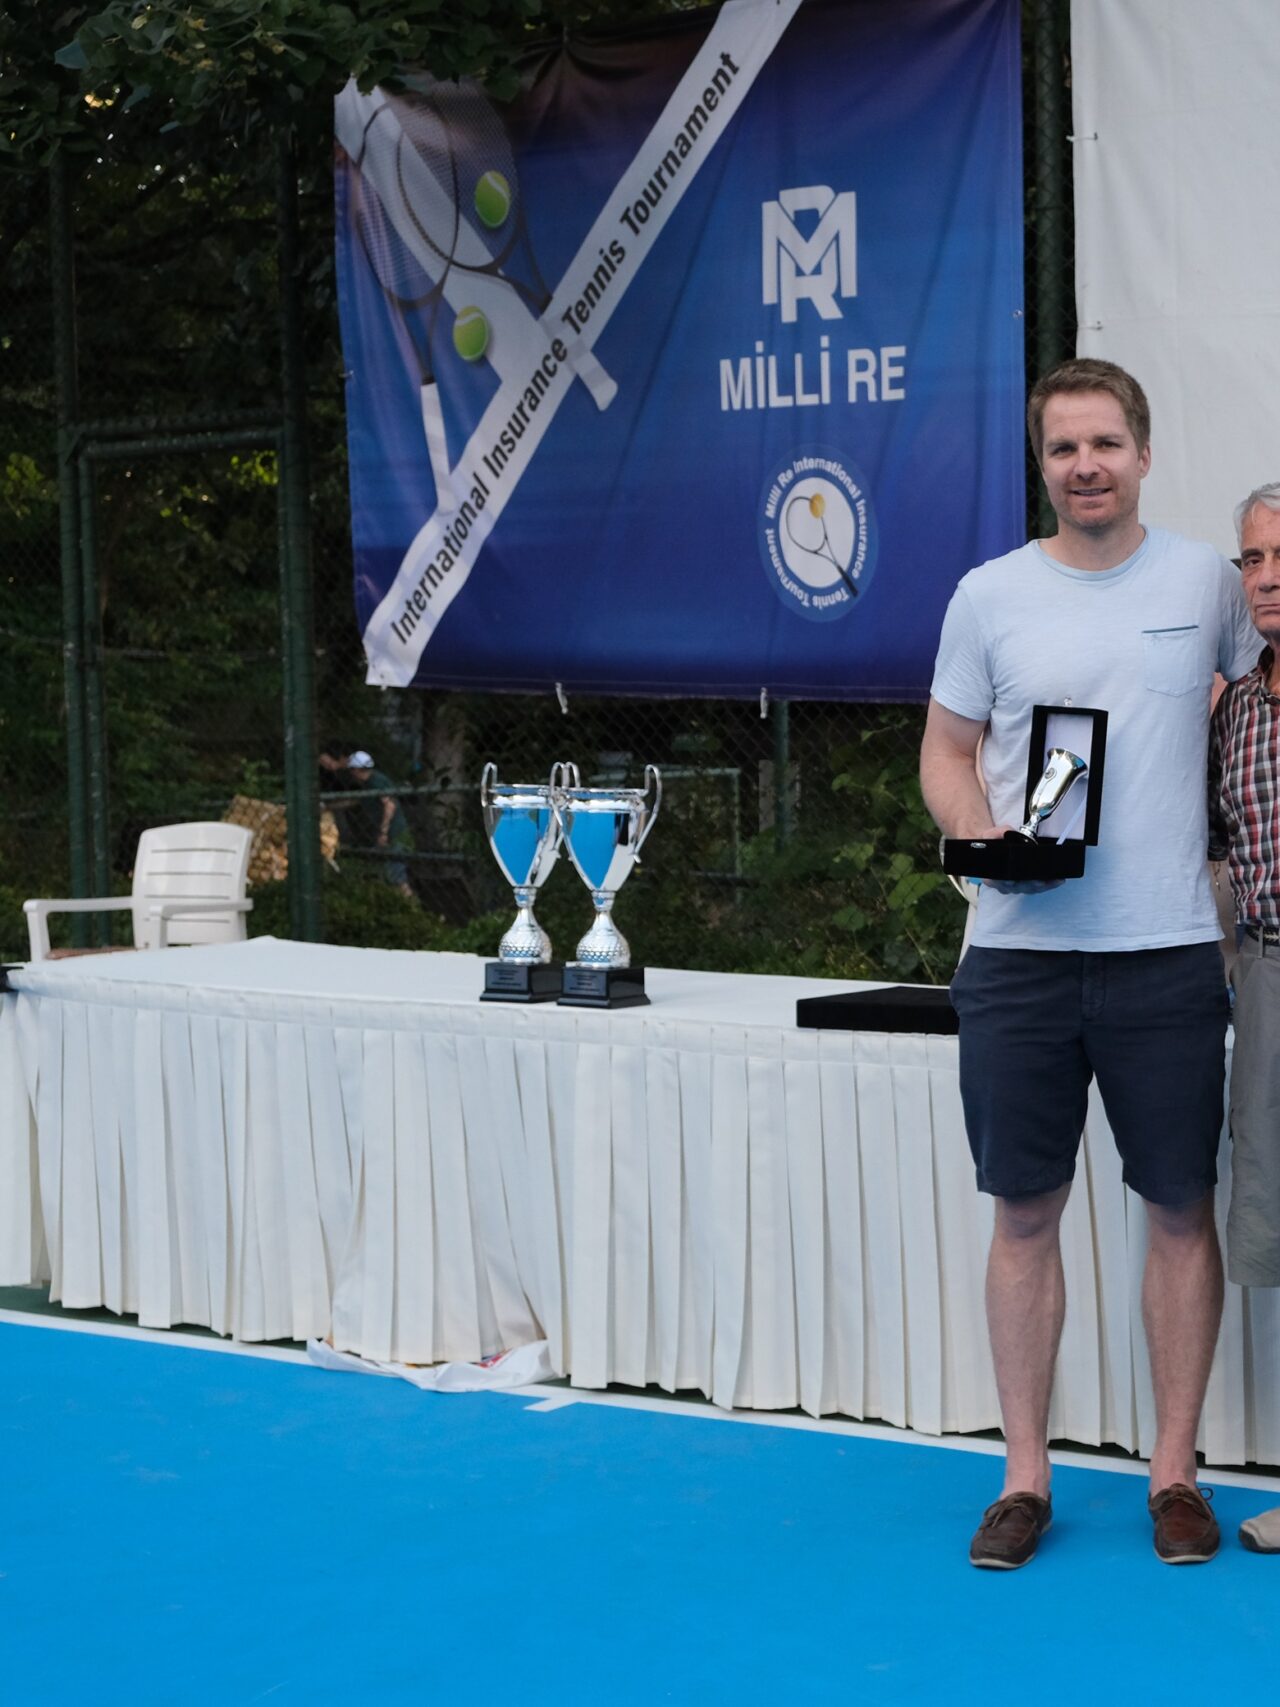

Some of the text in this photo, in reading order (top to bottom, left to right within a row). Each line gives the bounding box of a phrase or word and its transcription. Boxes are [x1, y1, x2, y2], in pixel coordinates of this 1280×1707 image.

[391, 51, 740, 645] International Insurance Tennis Tournament
[847, 345, 906, 403] RE
[765, 528, 810, 608] Tournament
[851, 499, 868, 579] Insurance
[812, 587, 850, 610] Tennis
